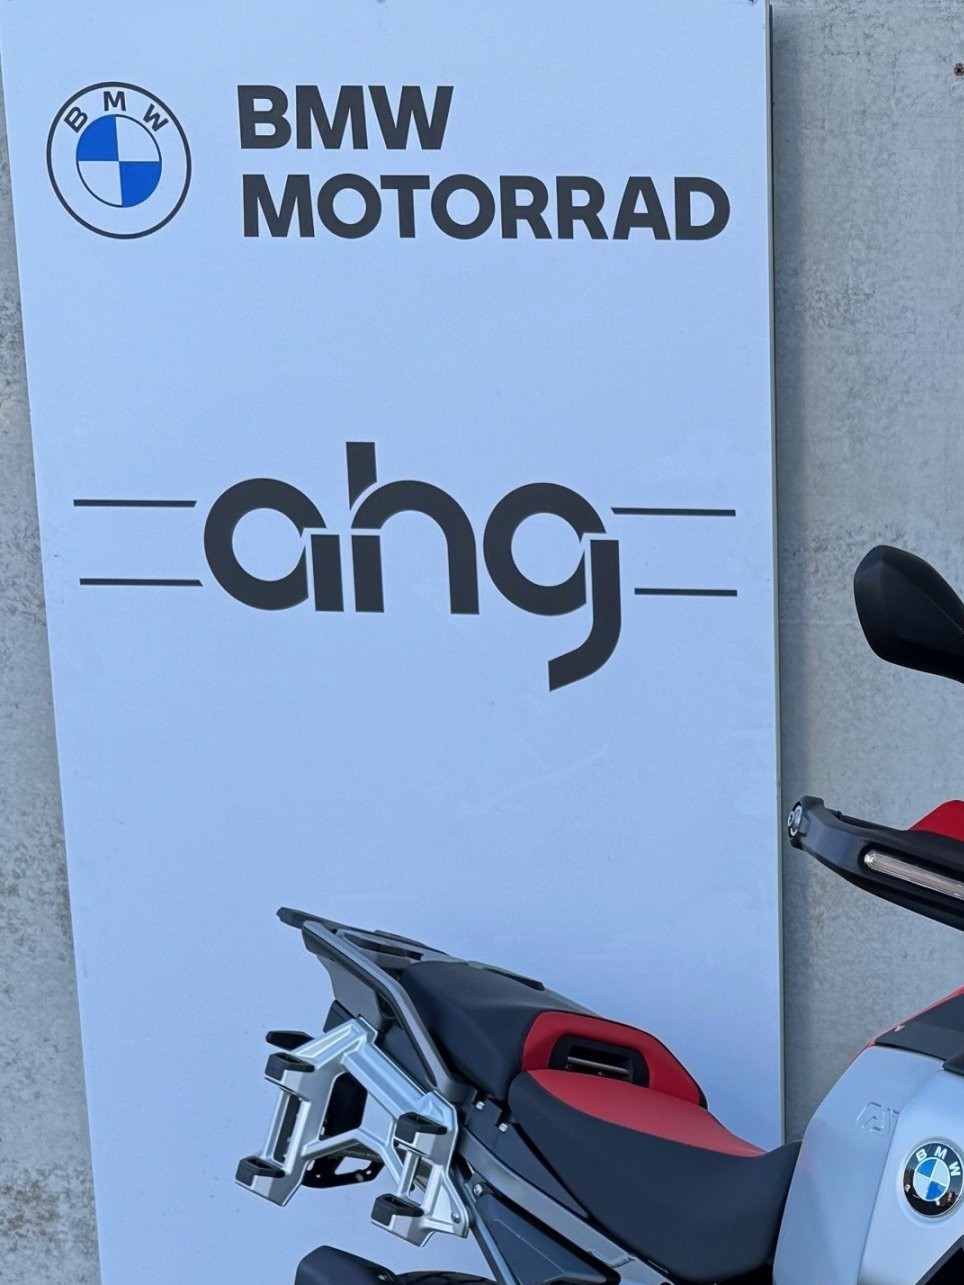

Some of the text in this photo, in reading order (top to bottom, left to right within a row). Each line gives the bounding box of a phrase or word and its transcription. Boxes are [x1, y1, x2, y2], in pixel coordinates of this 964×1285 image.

[64, 91, 169, 133] BMW
[238, 85, 453, 149] BMW
[243, 174, 730, 240] MOTORRAD
[204, 442, 622, 692] ahg
[915, 1146, 961, 1178] BMW
